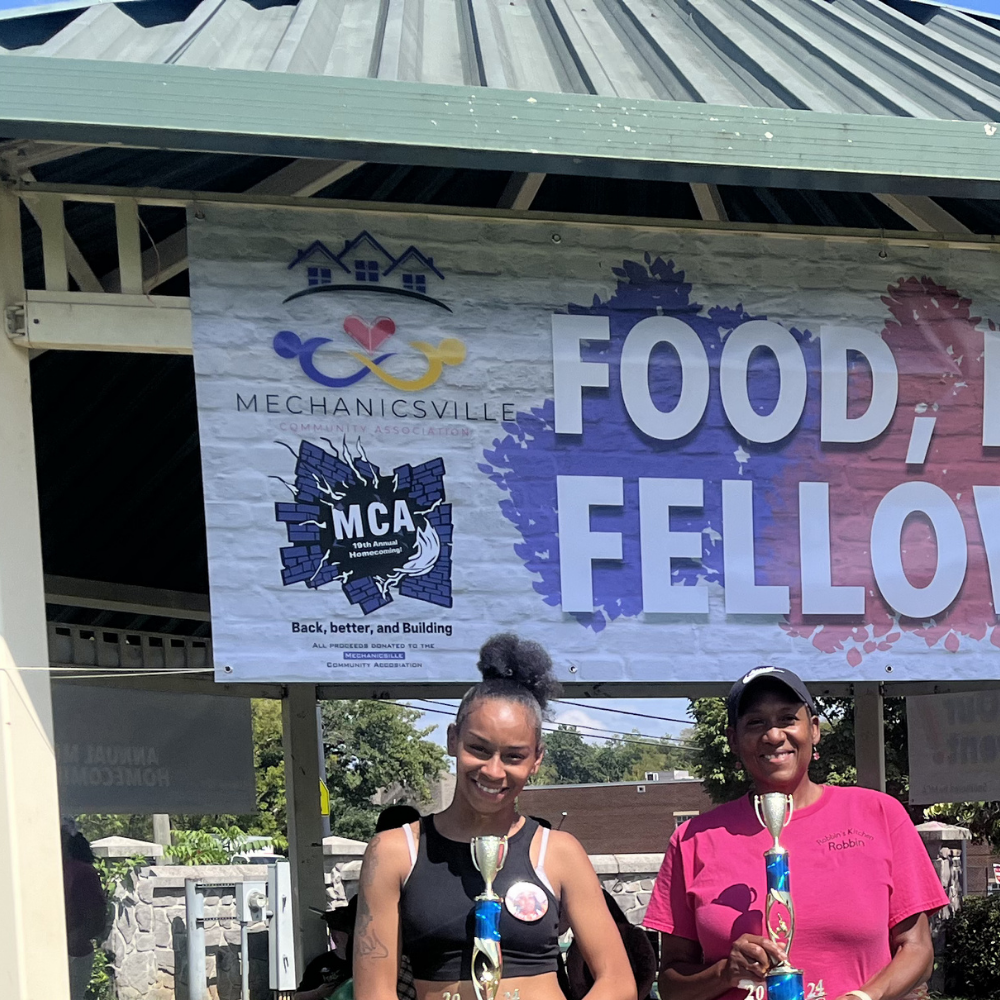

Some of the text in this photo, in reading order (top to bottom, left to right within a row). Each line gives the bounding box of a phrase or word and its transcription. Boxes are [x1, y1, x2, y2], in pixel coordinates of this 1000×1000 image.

[552, 313, 937, 464] FOOD,
[236, 392, 516, 422] MECHANICSVILLE
[280, 422, 471, 437] COMMUNITY ASSOCIATION
[332, 499, 416, 540] MCA
[373, 539, 399, 548] Annual
[292, 621, 453, 636] Back, better, and Building
[828, 838, 866, 851] Robbin
[744, 984, 765, 1000] 20
